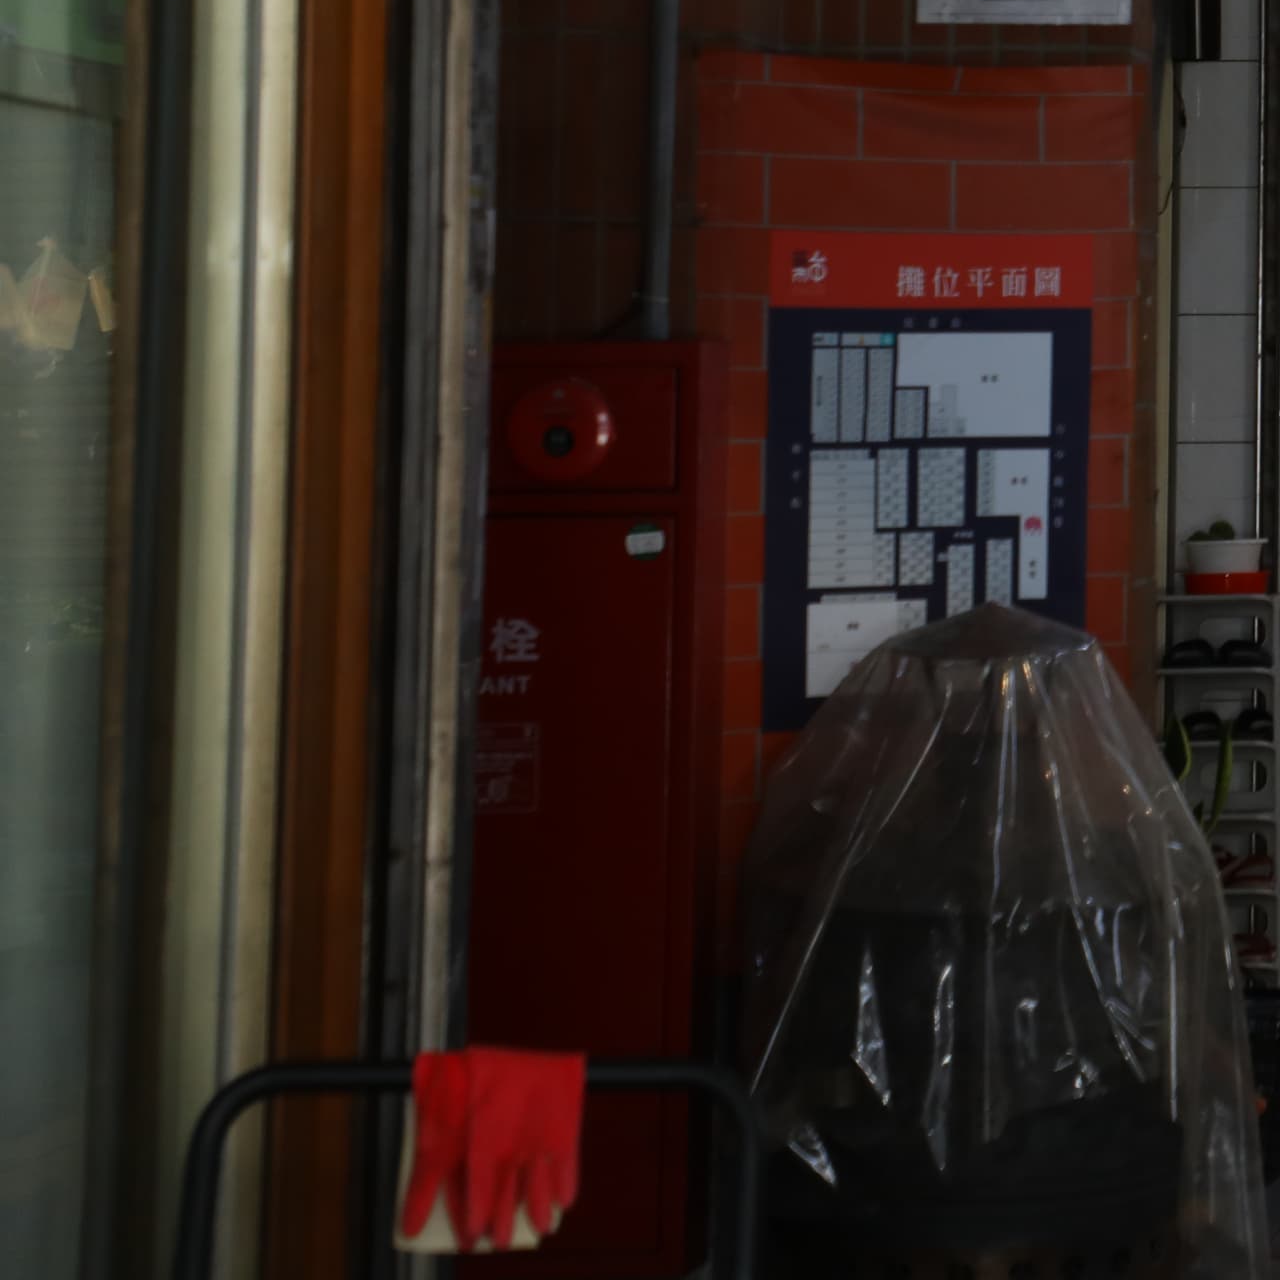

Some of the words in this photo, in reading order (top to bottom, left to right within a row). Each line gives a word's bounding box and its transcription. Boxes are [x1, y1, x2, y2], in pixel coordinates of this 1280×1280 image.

[895, 264, 1063, 299] 攤位平面圖
